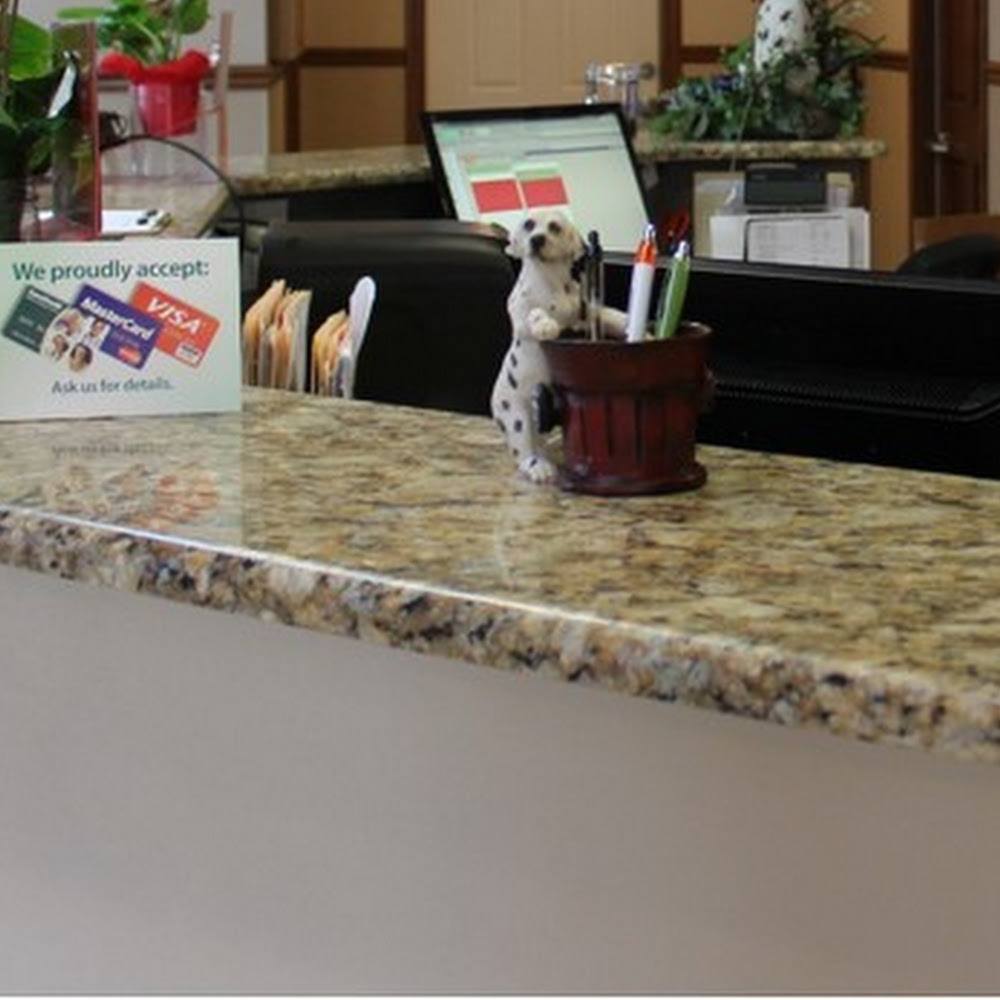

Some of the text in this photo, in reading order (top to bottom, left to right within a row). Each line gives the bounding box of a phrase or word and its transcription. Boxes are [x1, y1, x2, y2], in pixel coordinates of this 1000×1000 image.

[12, 259, 210, 282] We proudly accept:
[146, 297, 202, 335] VISA
[52, 381, 79, 394] Ask
[81, 383, 97, 393] us
[101, 379, 121, 392] for
